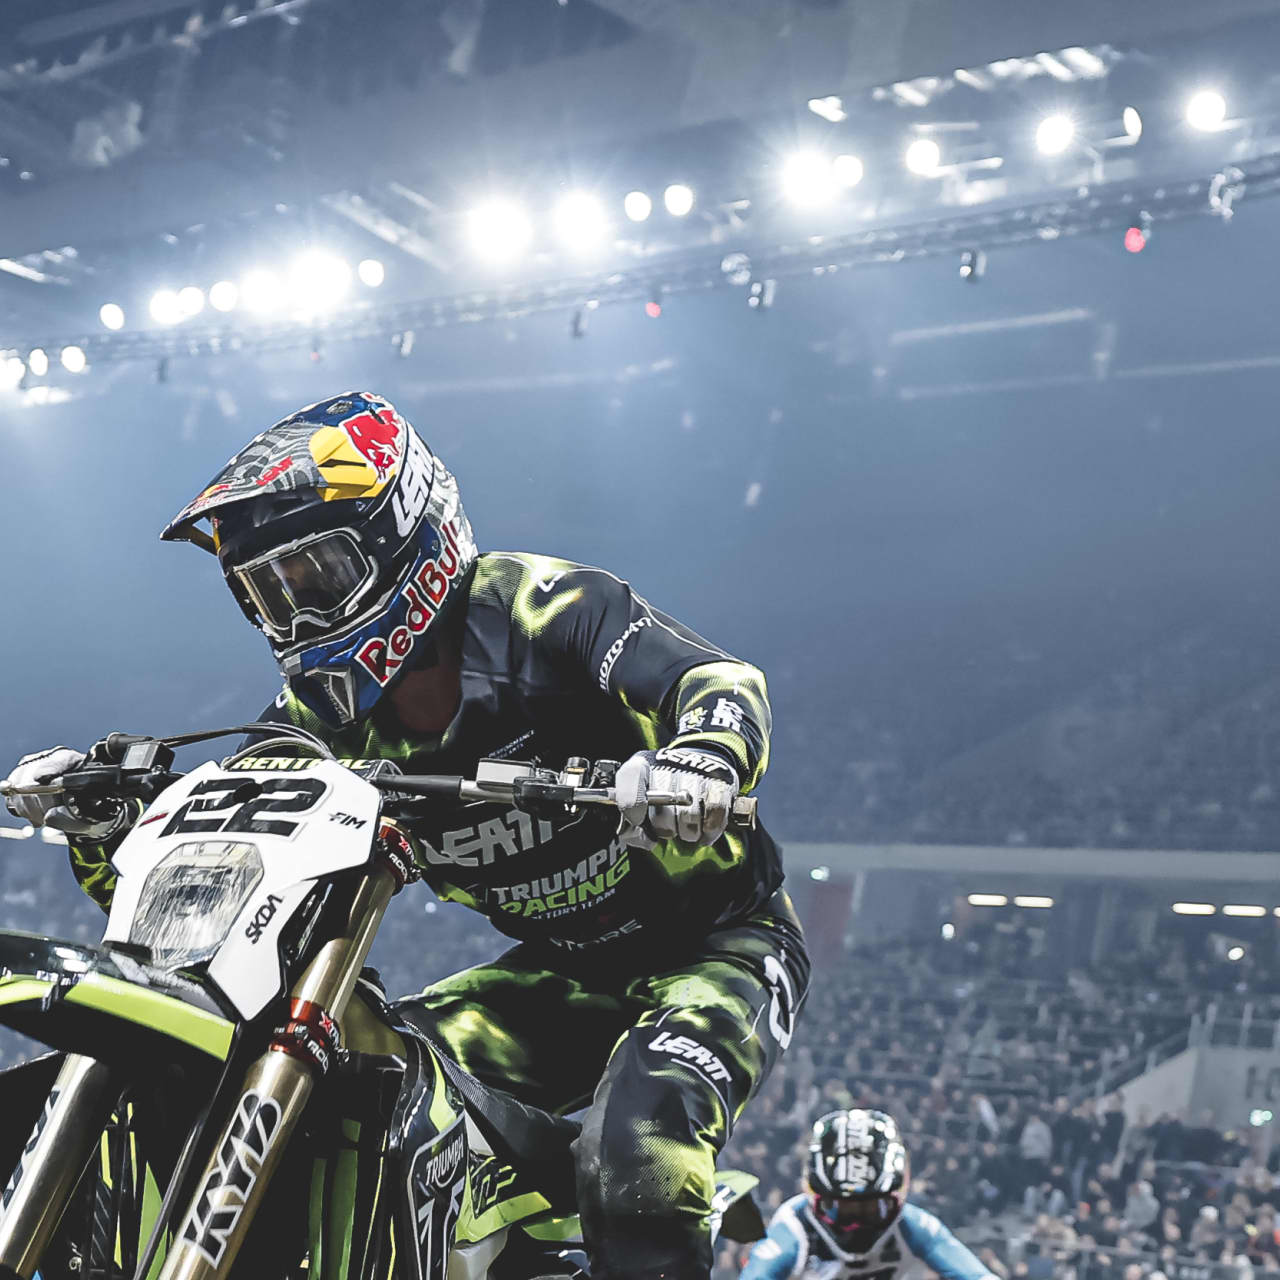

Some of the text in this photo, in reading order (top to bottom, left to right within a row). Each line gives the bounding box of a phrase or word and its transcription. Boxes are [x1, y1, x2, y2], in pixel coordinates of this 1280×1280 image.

[392, 425, 434, 537] LEAT
[354, 520, 462, 688] Red Bull
[656, 747, 729, 773] LEATT
[157, 777, 328, 840] 22
[329, 811, 368, 830] FIM
[491, 839, 630, 905] TRIUMPH
[500, 852, 632, 918] RACING
[245, 894, 285, 944] SKDA
[648, 1031, 733, 1083] LEATT
[183, 1088, 282, 1271] KYB
[426, 1132, 464, 1188] TRIUMPH
